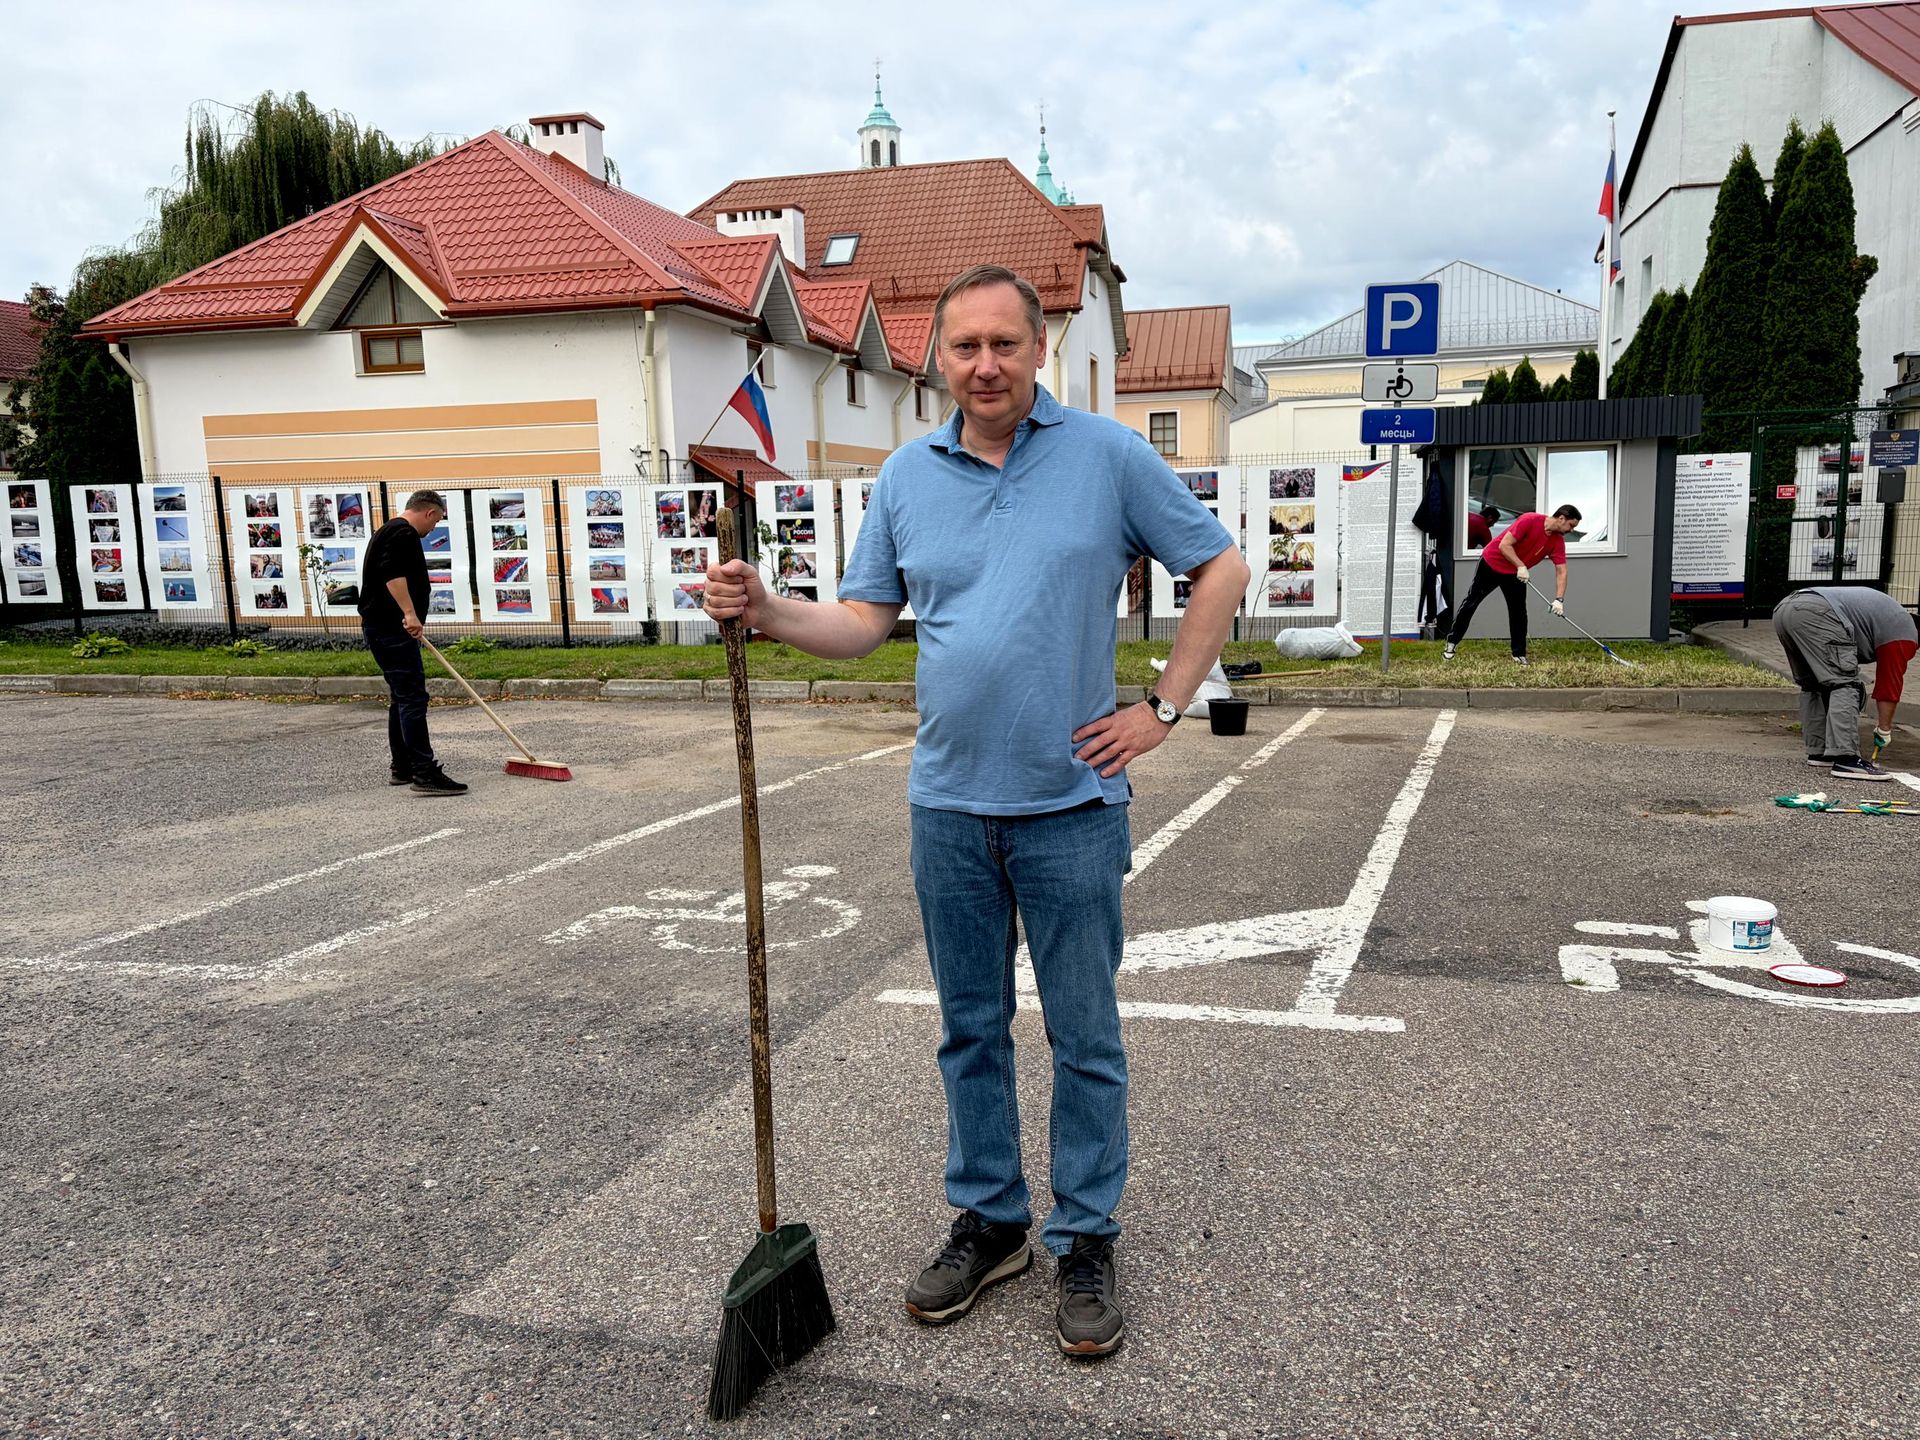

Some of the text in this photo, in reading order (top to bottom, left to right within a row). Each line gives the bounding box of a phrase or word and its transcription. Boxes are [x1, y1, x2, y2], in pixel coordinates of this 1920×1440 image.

[1382, 292, 1422, 350] P
[1394, 414, 1401, 425] 2
[1380, 429, 1415, 439] месцы
